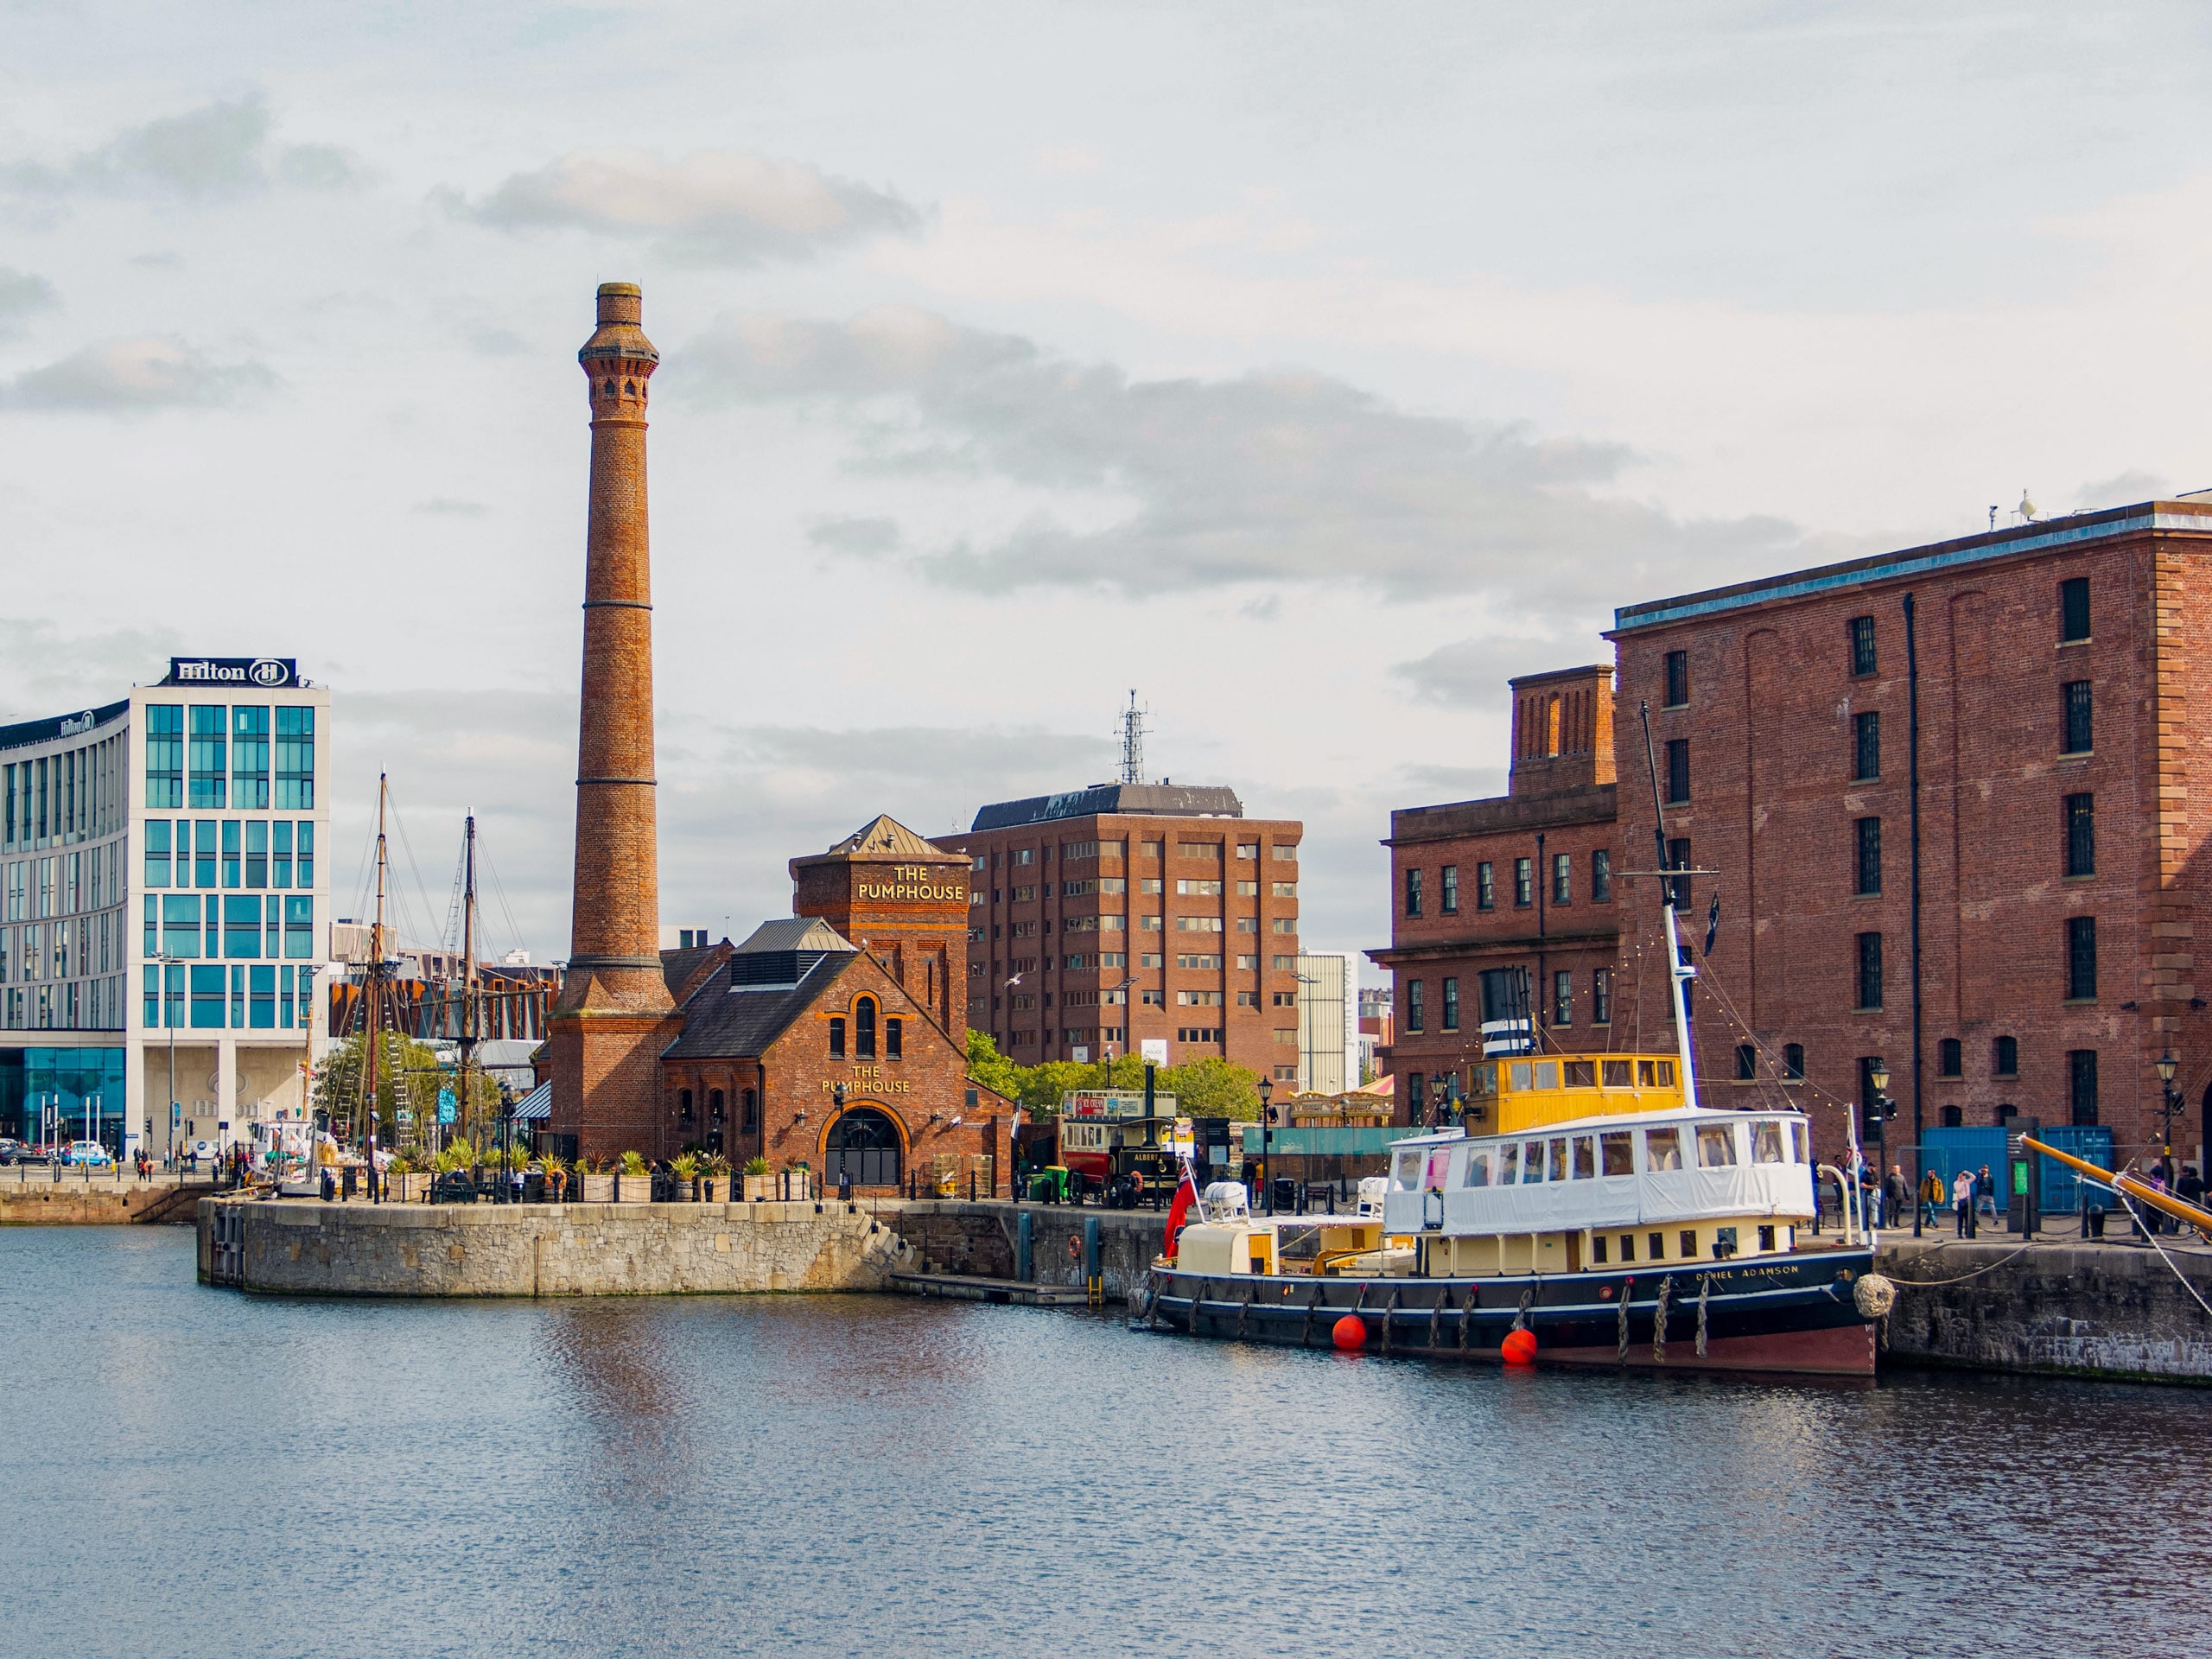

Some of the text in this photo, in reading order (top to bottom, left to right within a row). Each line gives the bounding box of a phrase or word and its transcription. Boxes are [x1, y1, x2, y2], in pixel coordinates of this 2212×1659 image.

[178, 661, 246, 681] Hilton
[60, 718, 81, 737] Hilton
[893, 867, 927, 881] THE
[858, 884, 963, 900] PUMPHOUSE
[853, 1065, 880, 1077] THE
[194, 1099, 262, 1117] Hion
[1696, 1266, 1798, 1281] DANIEL ADAMSON
